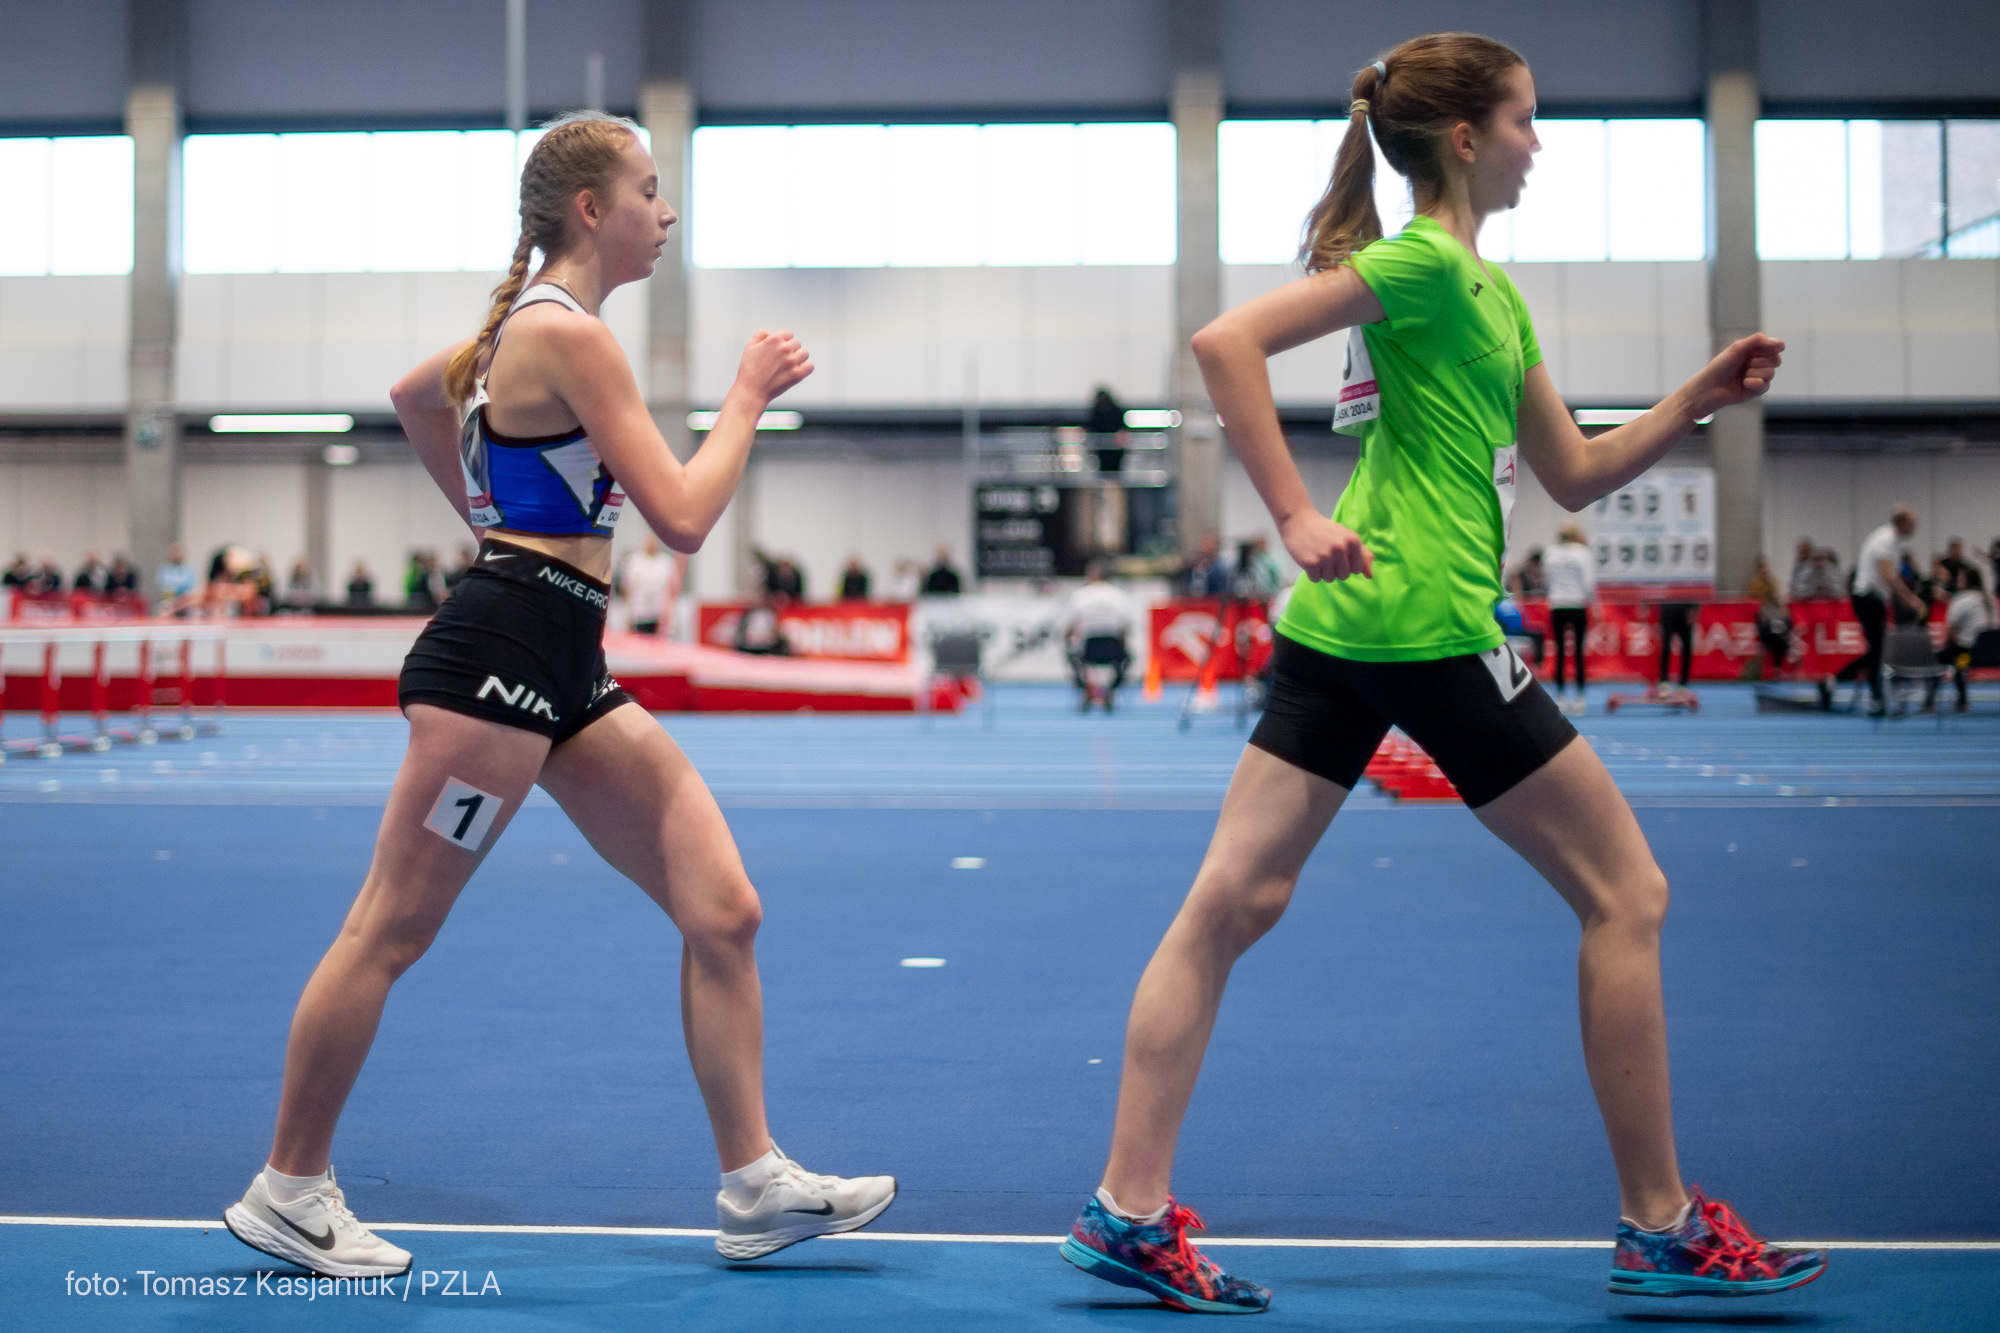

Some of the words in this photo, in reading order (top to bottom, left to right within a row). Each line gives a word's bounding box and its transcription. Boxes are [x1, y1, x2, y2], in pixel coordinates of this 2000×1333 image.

[1350, 401, 1373, 417] 2024
[537, 565, 587, 598] NIKE
[586, 589, 608, 610] PRO
[1492, 642, 1529, 690] 2
[477, 675, 560, 722] NIK
[453, 793, 485, 841] 1
